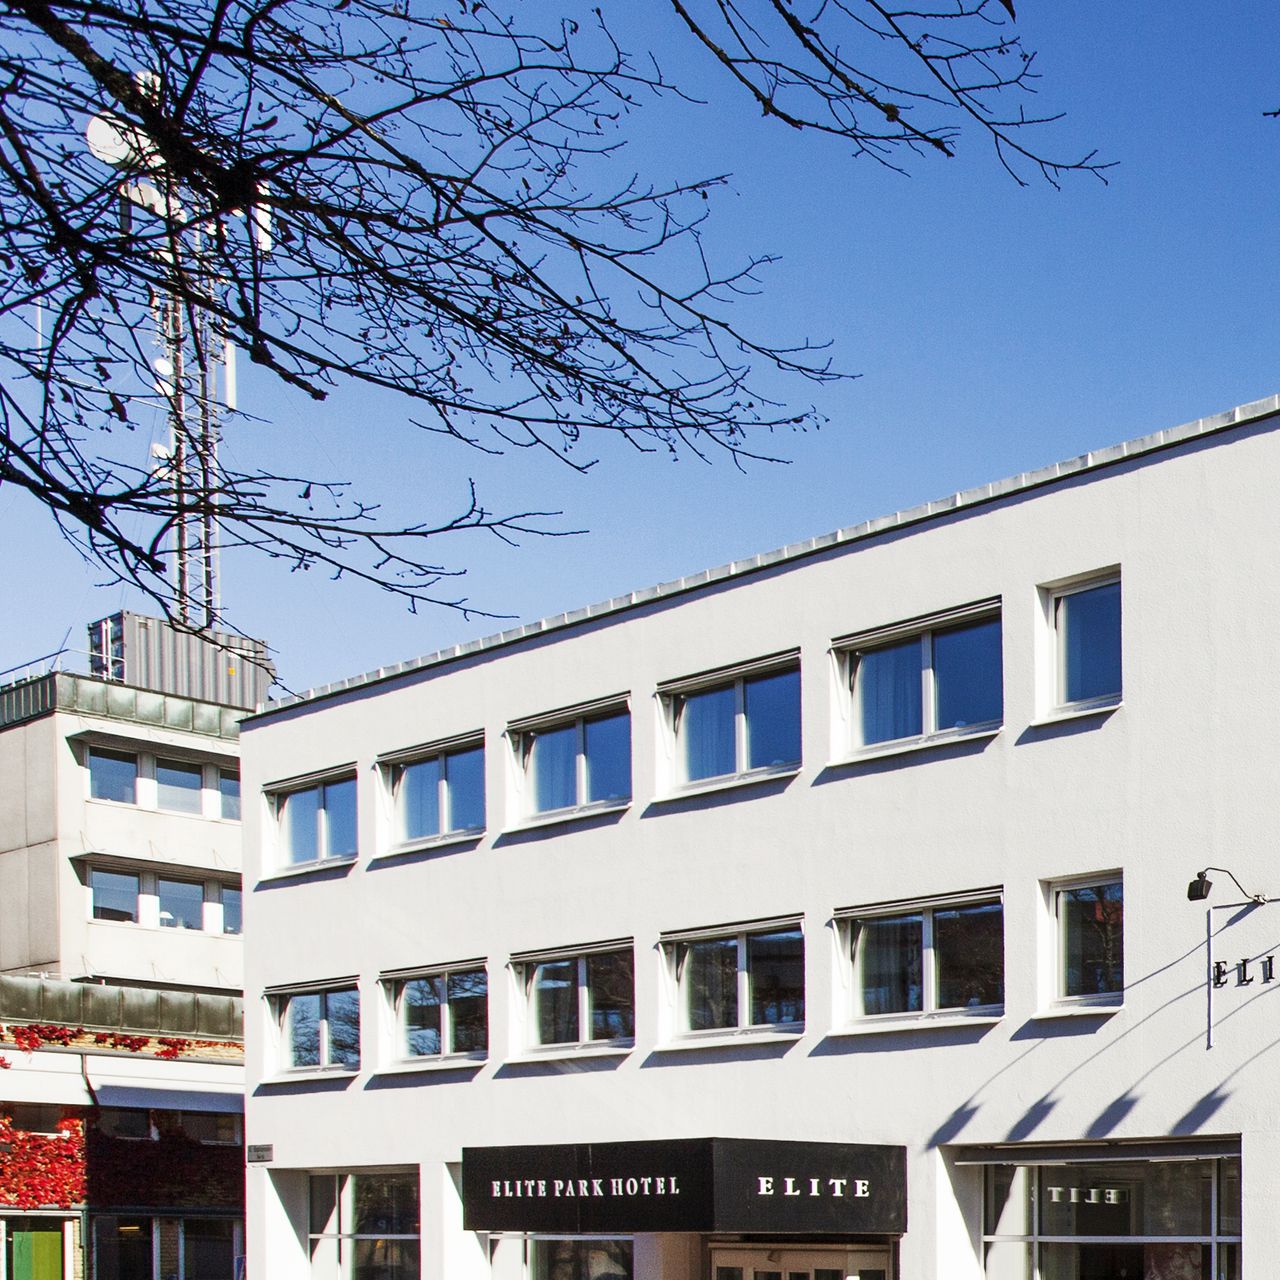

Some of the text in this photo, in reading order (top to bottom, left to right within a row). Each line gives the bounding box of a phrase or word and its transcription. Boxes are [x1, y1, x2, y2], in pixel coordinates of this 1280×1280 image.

[491, 1176, 680, 1198] ELITE PARK HOTEL
[757, 1176, 870, 1198] ELITE
